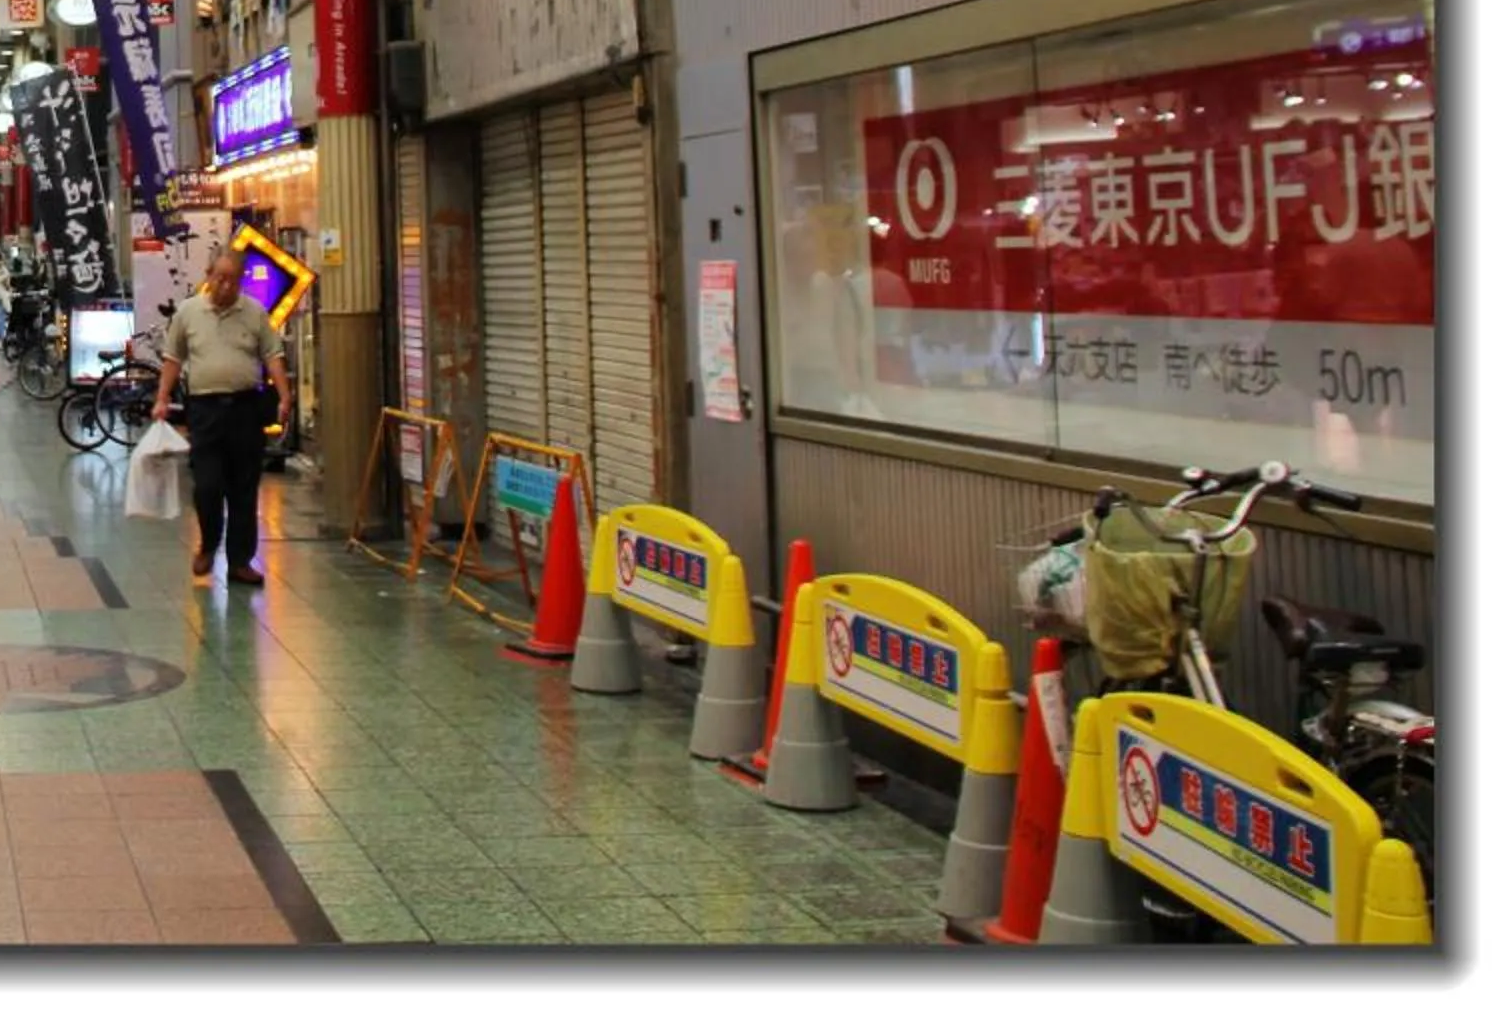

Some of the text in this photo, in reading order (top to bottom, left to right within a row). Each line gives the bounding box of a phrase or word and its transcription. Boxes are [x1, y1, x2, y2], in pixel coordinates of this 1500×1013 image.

[908, 257, 951, 284] MUFG
[1043, 334, 1138, 385] 天六支店
[1318, 348, 1408, 408] 50m
